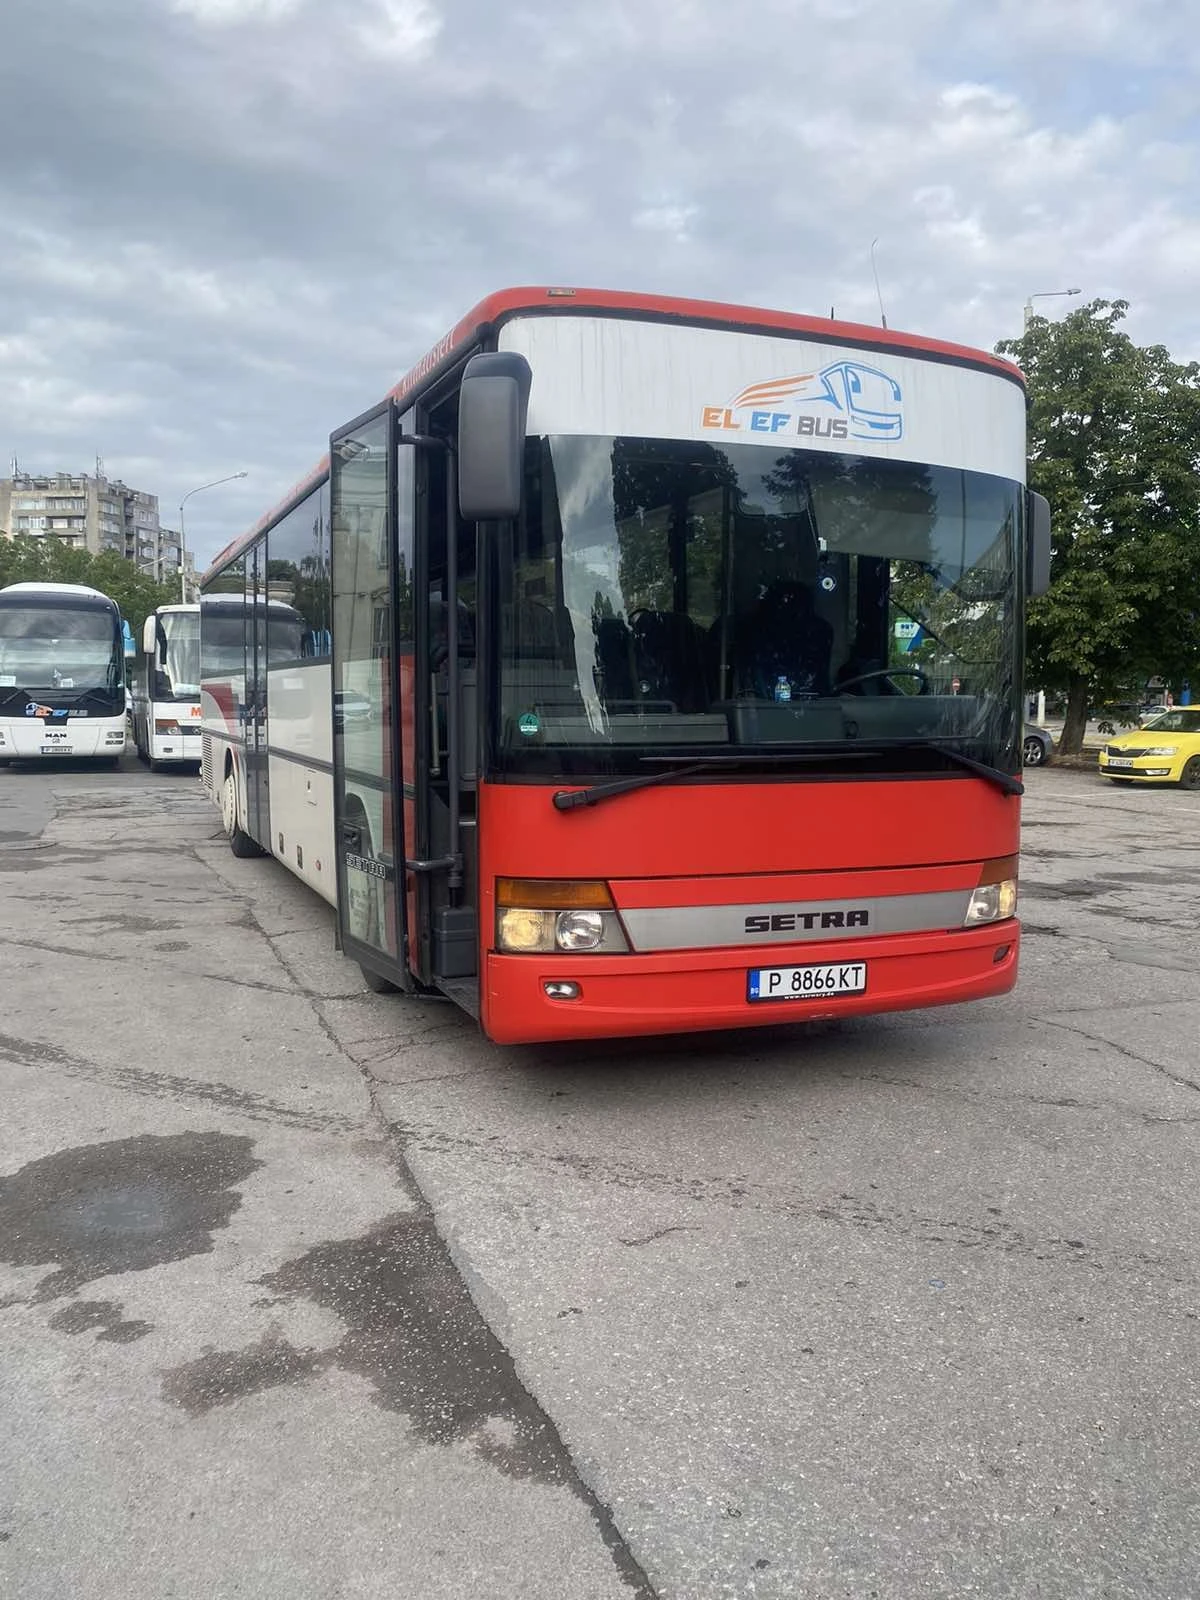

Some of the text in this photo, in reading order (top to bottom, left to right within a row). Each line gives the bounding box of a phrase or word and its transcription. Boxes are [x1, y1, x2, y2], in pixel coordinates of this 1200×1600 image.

[702, 407, 848, 439] EL EF BUS
[346, 852, 386, 879] SETRA
[745, 910, 869, 933] SETRA
[769, 972, 781, 993] P
